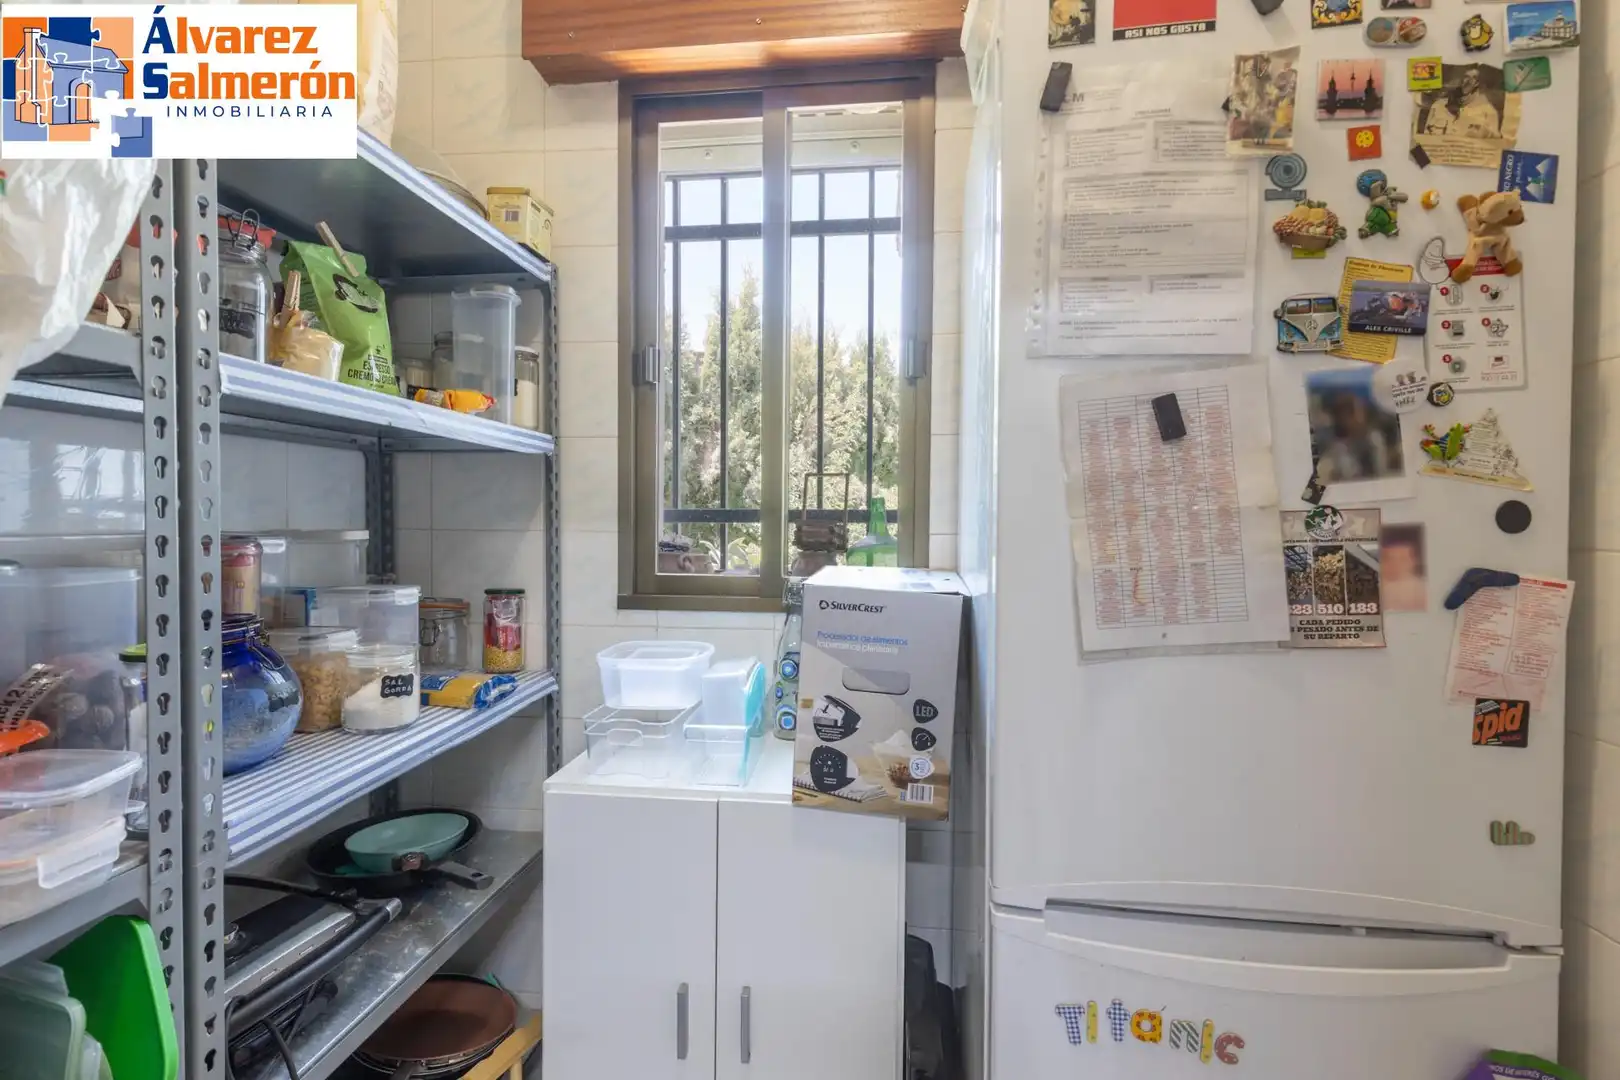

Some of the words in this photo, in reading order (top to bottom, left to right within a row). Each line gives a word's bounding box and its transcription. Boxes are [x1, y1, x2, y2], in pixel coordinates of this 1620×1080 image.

[1145, 25, 1168, 36] NOS
[1170, 23, 1207, 35] GUSTA
[1318, 603, 1344, 614] 510
[1349, 602, 1378, 614] 183
[1325, 618, 1361, 626] PEDIDO
[1317, 632, 1361, 640] REPARTO
[384, 685, 412, 694] GORDA
[914, 705, 934, 718] LED
